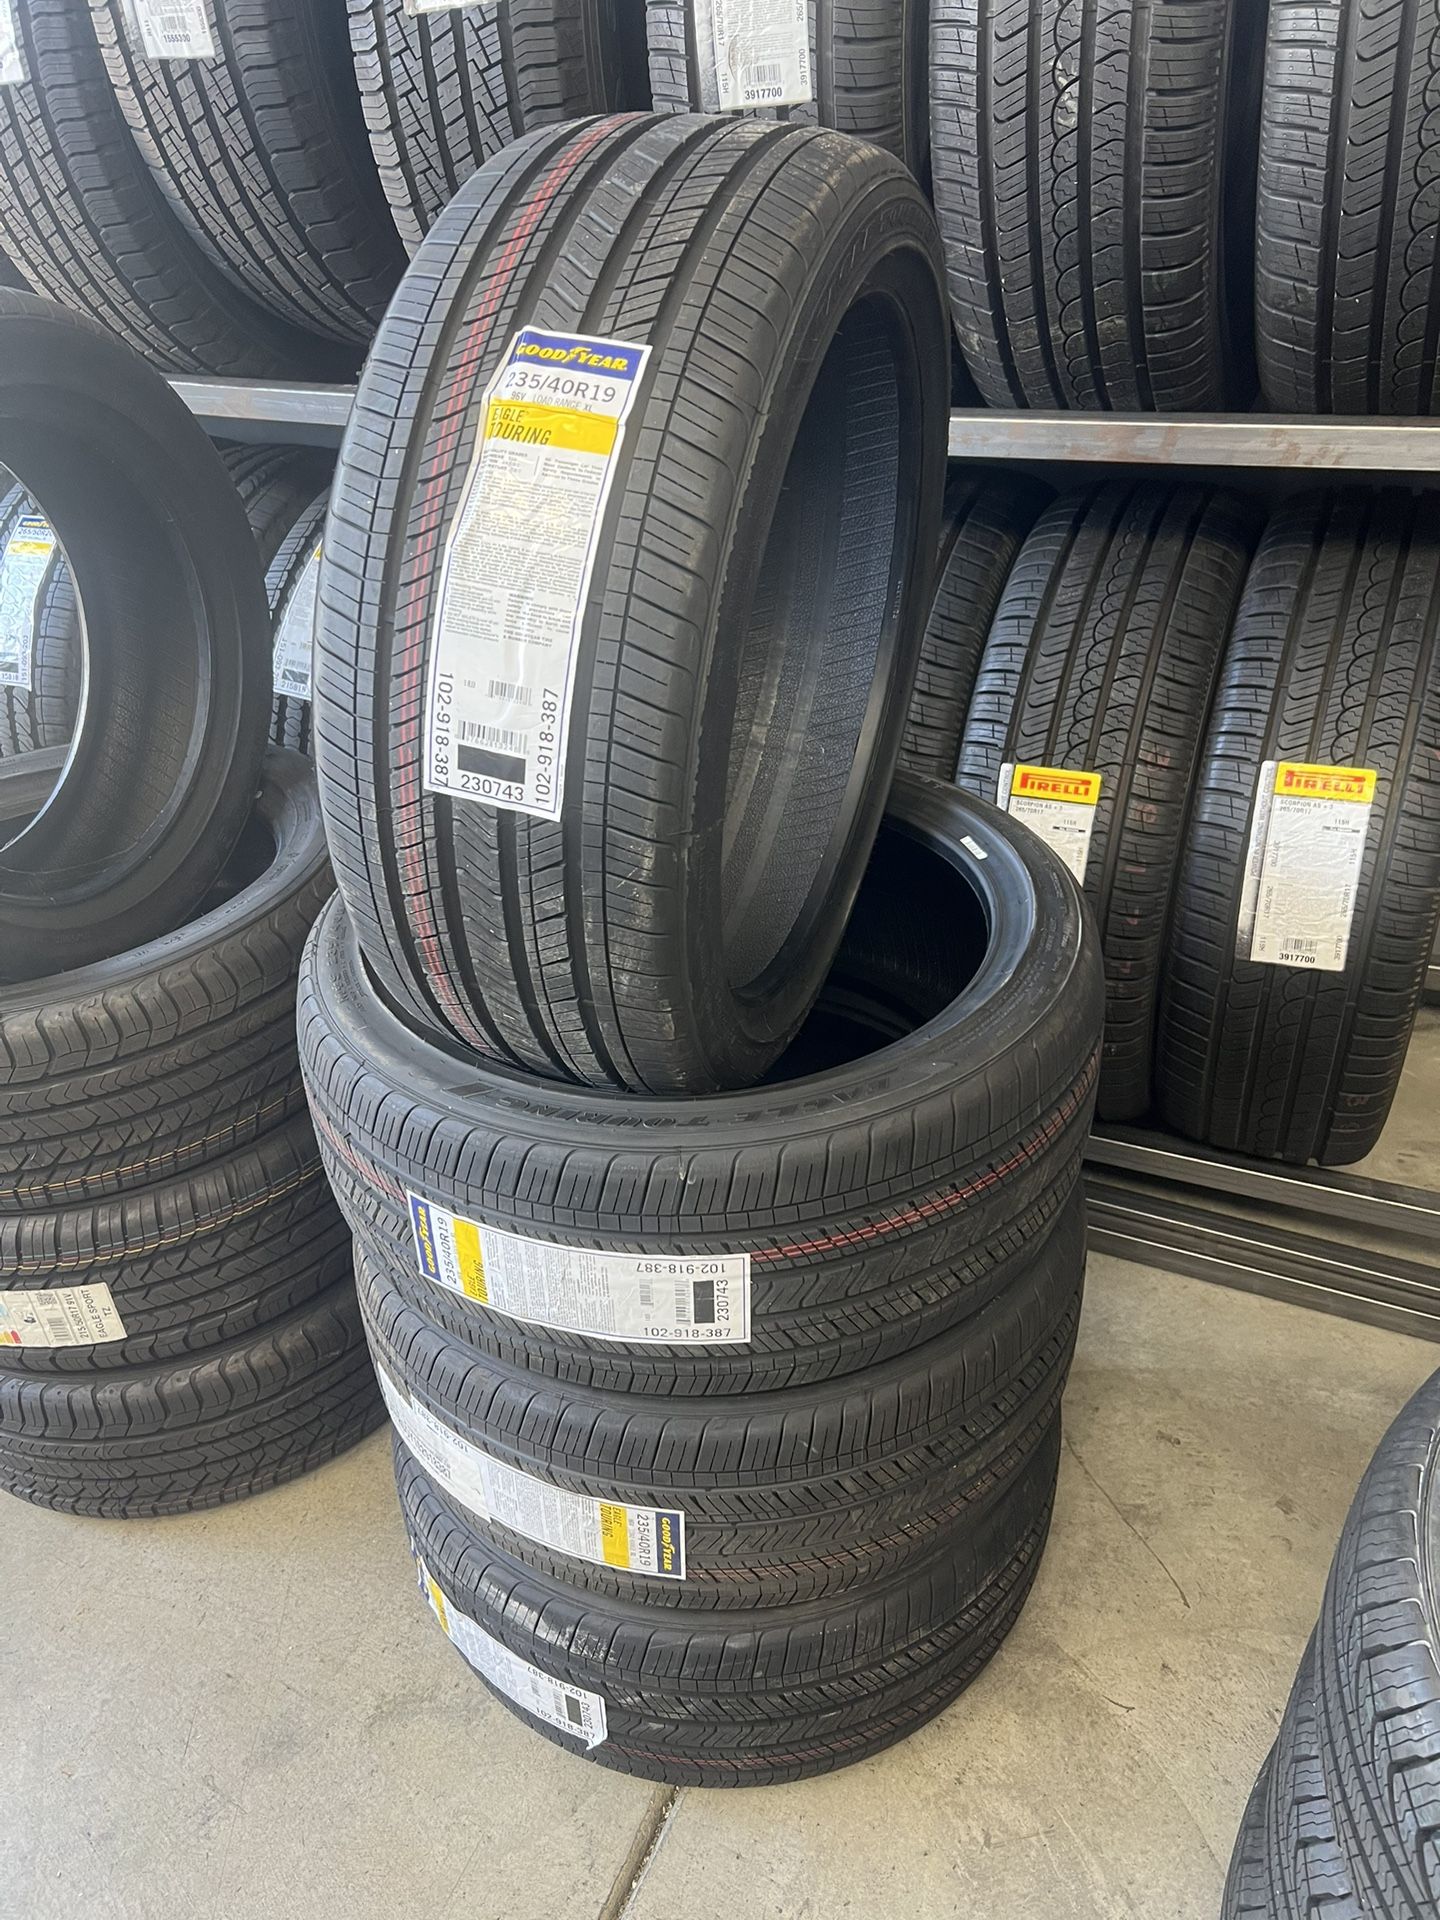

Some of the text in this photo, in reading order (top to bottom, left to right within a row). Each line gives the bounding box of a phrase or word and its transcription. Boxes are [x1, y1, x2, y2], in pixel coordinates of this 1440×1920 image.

[798, 48, 808, 86] 3917700
[744, 87, 783, 100] 3917700
[515, 343, 629, 372] GOODYEAR
[506, 371, 617, 403] 235/40R19
[434, 672, 454, 788] 102-918-387
[535, 688, 559, 804] 102-918-387
[461, 774, 524, 801] 230743
[1020, 772, 1092, 797] PIRELLI
[1284, 769, 1366, 794] PIRELLI
[1280, 799, 1312, 808] SCORPION
[1279, 952, 1316, 965] 3917700
[417, 1206, 437, 1275] GOODYEAR
[437, 1216, 457, 1285] 235/40R19
[636, 1262, 726, 1275] 102-918-387
[81, 1289, 108, 1338] EAGLE SPORT
[102, 1306, 113, 1317] TZ
[716, 1279, 730, 1322] 230743
[643, 1327, 732, 1338] 102-918-387
[636, 1513, 651, 1567] 235/40R19
[660, 1516, 675, 1572] GOODYEAR
